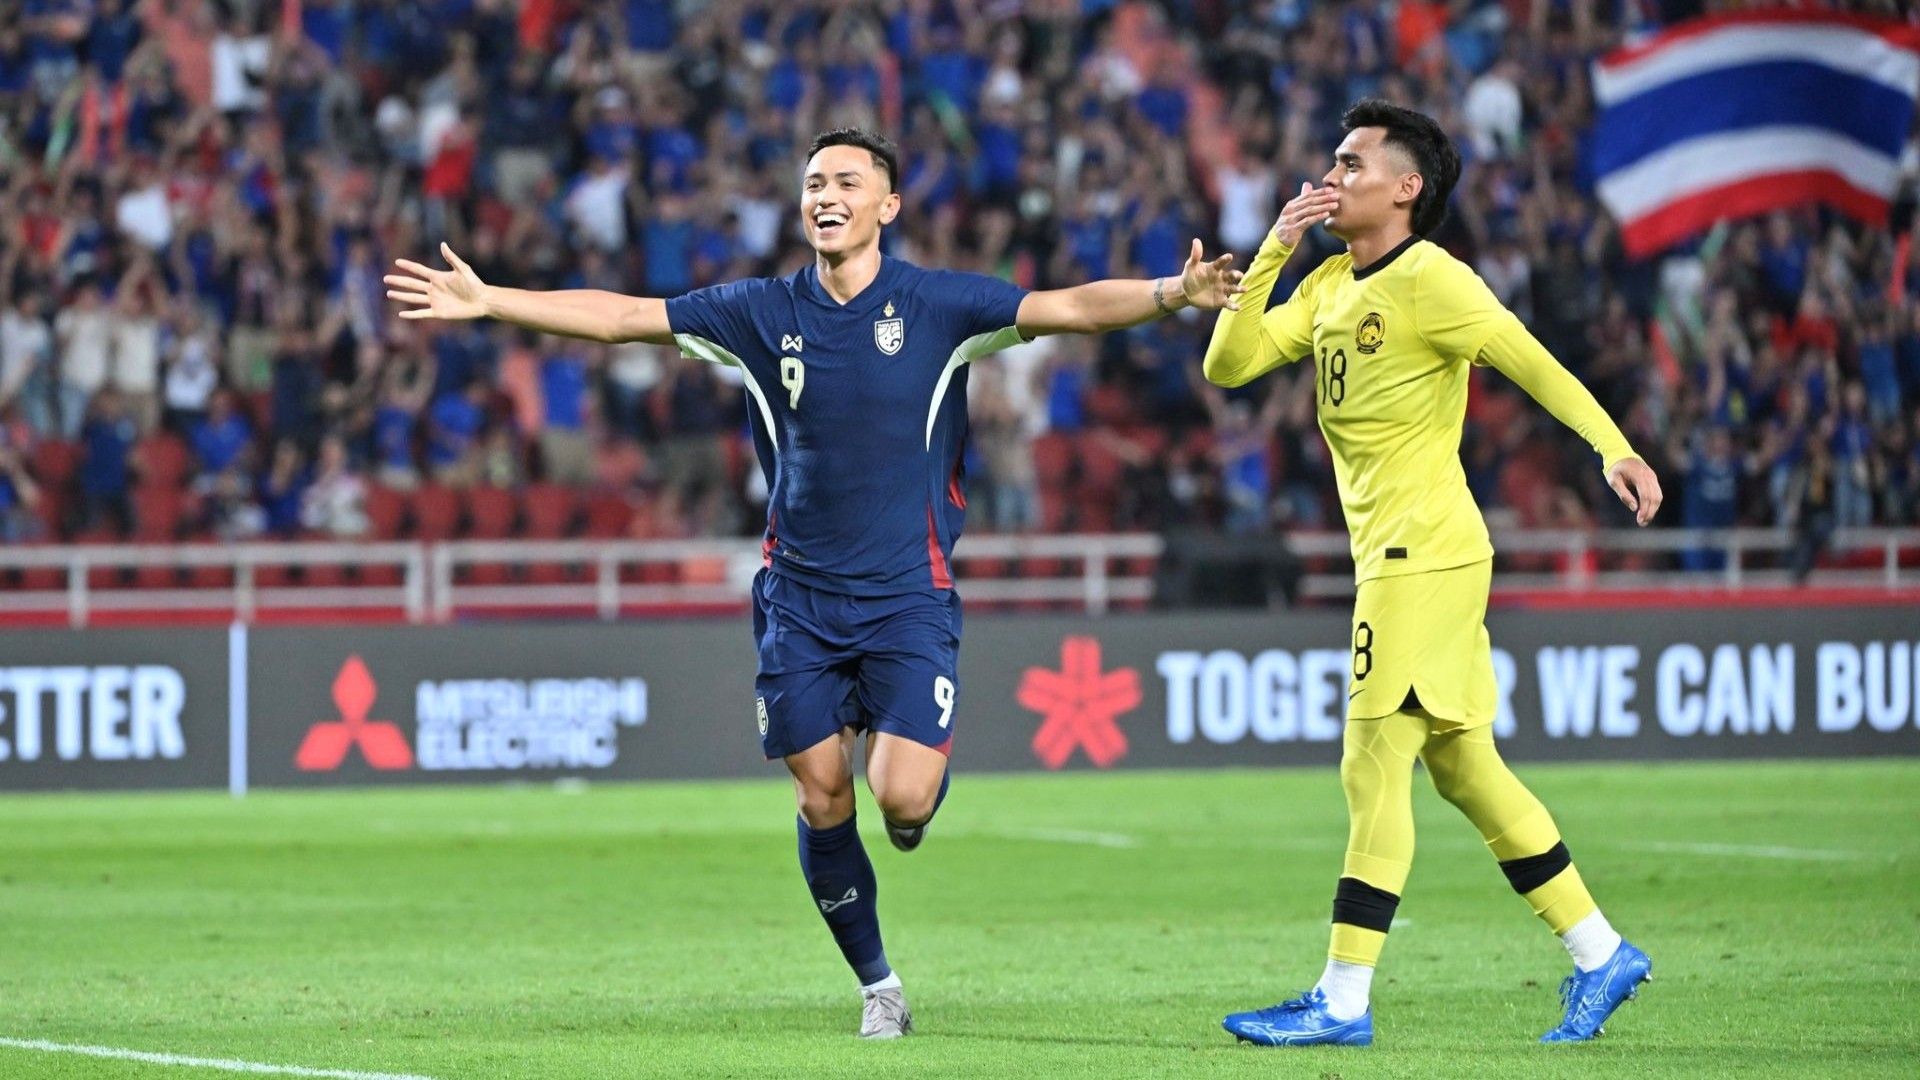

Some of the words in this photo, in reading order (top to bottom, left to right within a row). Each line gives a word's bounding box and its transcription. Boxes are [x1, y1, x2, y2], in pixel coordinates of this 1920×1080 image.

[780, 356, 805, 410] 9
[1321, 347, 1347, 407] 18
[1354, 622, 1373, 681] 8
[0, 665, 187, 761] TTER
[934, 676, 954, 729] 9
[1537, 645, 1640, 738] WE
[1656, 643, 1796, 736] CAN
[1816, 641, 1920, 732] BU
